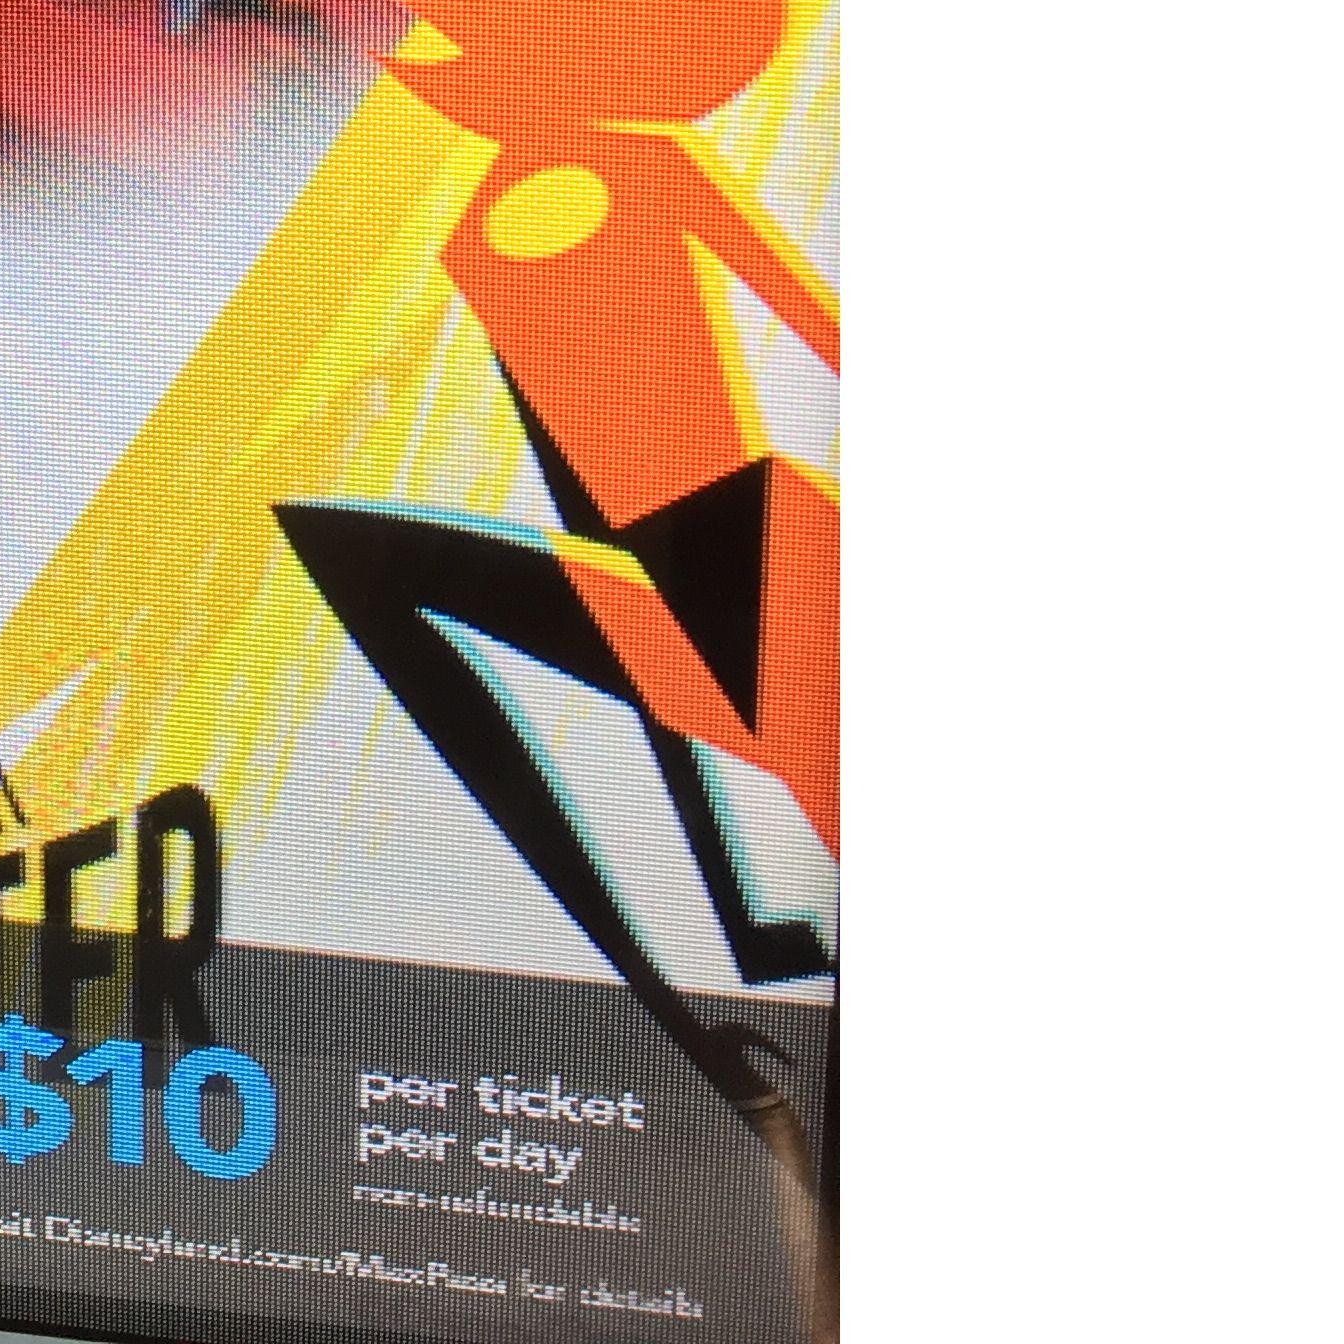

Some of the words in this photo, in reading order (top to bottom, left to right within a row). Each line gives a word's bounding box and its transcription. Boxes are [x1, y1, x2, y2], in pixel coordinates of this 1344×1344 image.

[359, 1069, 458, 1111] per
[473, 1071, 645, 1131] ticket
[359, 1122, 458, 1165] per
[473, 1128, 583, 1187] day
